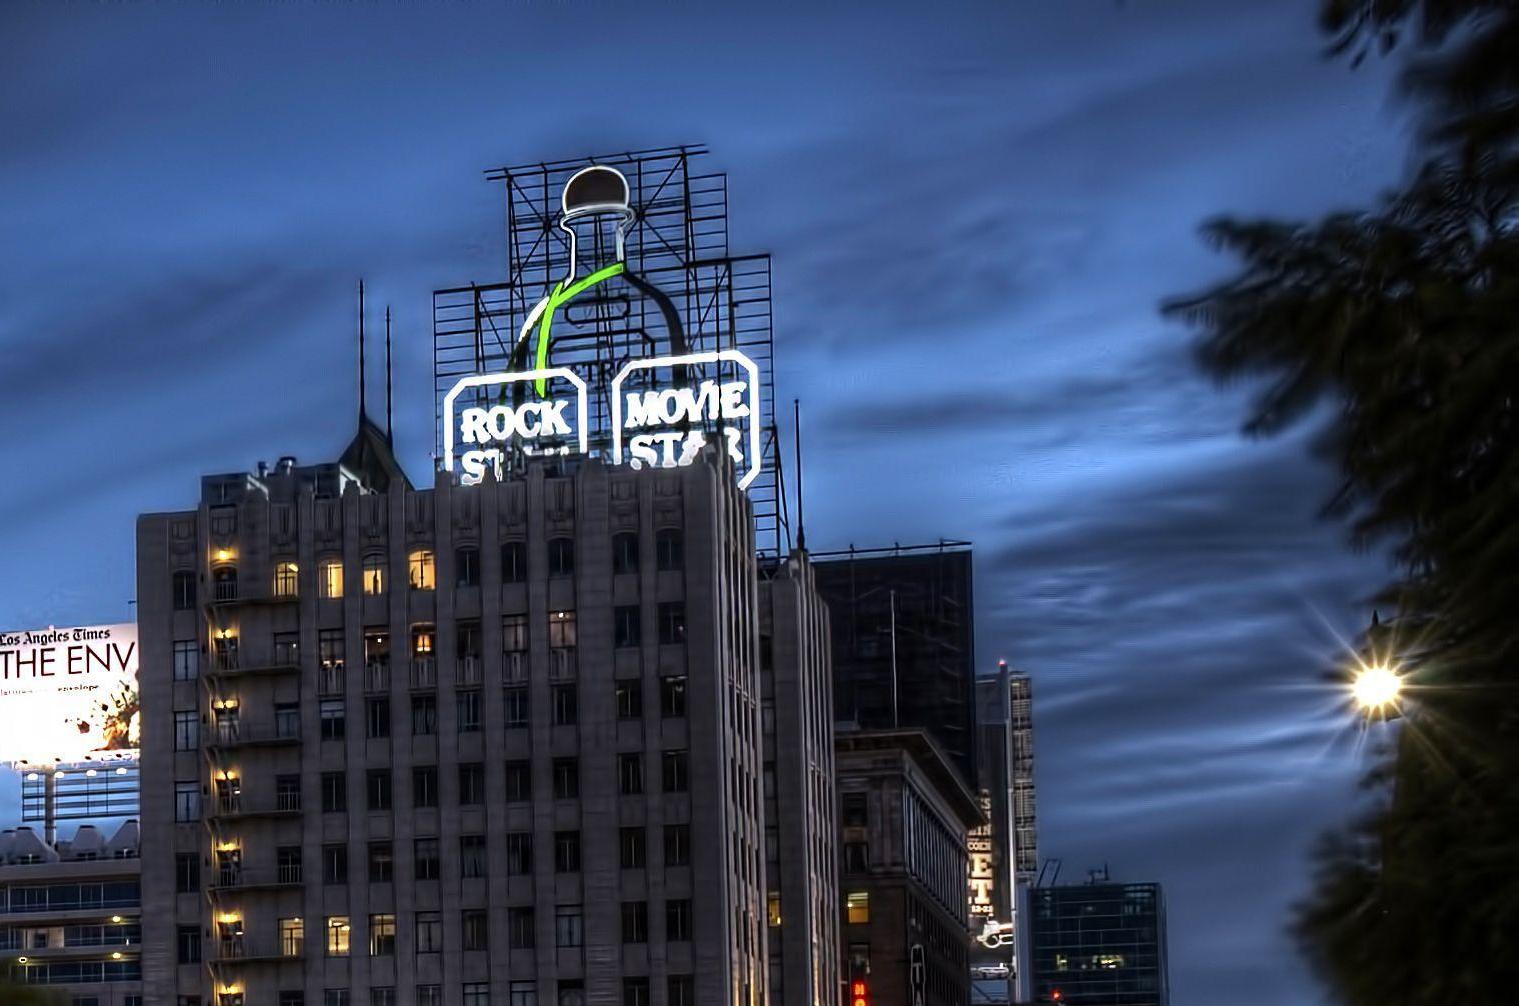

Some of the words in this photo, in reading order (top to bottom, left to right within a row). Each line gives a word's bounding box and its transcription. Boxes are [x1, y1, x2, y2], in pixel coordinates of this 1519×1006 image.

[461, 400, 572, 444] ROCK
[625, 380, 750, 428] MOVIE
[22, 631, 70, 646] Angeles
[72, 628, 111, 641] Times
[67, 641, 135, 675] ENV
